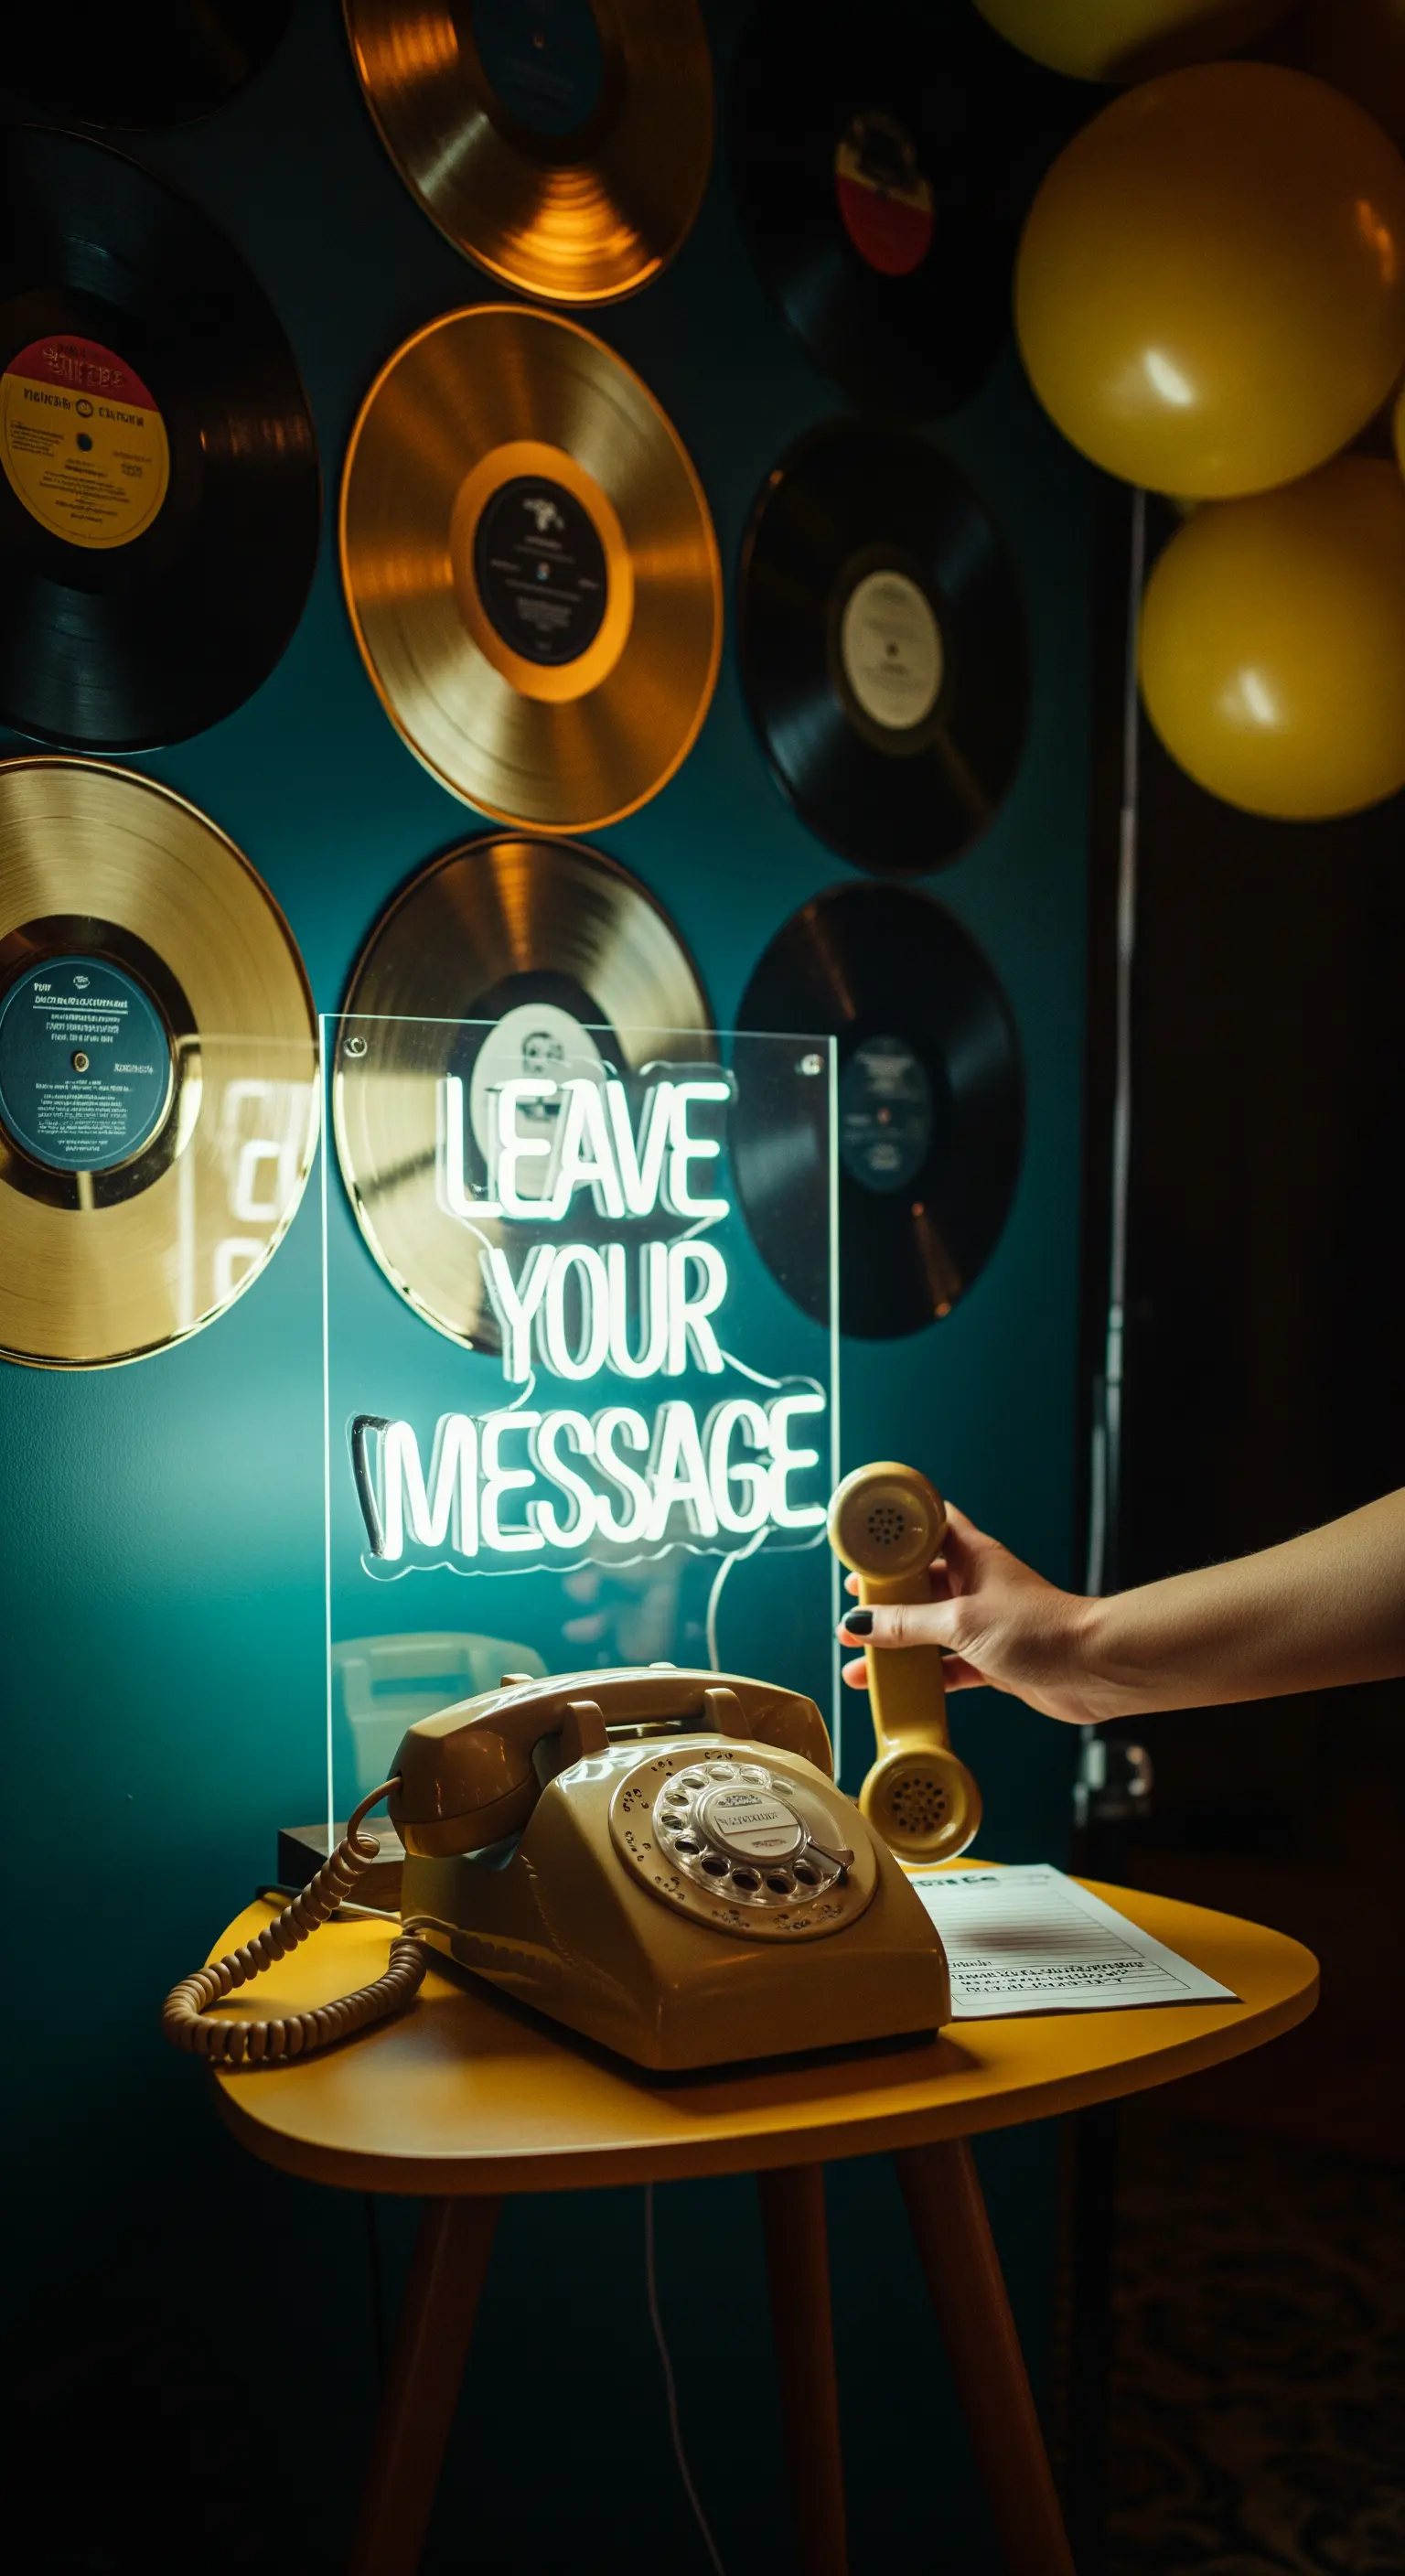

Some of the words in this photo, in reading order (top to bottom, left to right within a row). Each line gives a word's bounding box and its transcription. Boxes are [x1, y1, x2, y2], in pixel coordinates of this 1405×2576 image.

[441, 1076, 730, 1221] LEAVE
[485, 1240, 729, 1384] YOUR
[381, 1393, 828, 1561] MESSAGE
